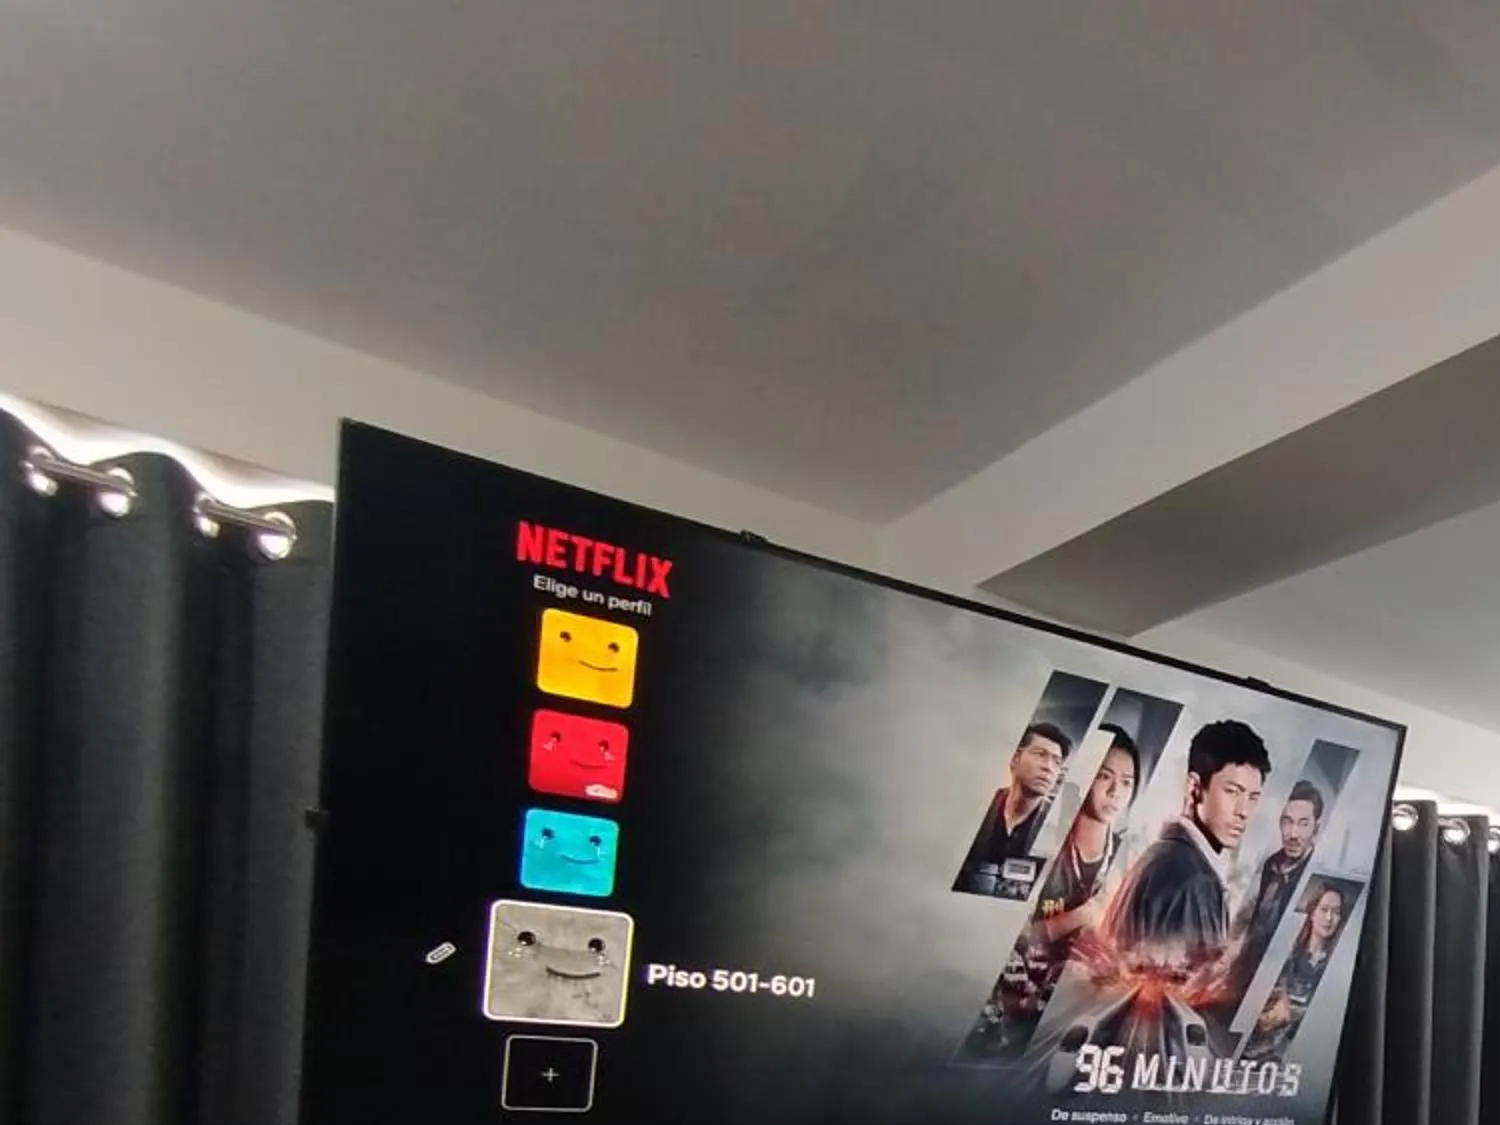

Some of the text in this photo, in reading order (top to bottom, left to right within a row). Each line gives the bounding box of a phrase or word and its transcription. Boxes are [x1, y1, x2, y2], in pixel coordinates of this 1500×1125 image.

[516, 520, 673, 599] NETFLIX
[533, 574, 652, 616] Elige un perfil
[647, 963, 816, 998] Piso 501-601
[1074, 1044, 1301, 1097] 96 MINUTOS
[1051, 1108, 1069, 1122] De
[1071, 1111, 1127, 1124] suspenso
[1143, 1111, 1188, 1125] Emotivo
[1203, 1113, 1219, 1125] De
